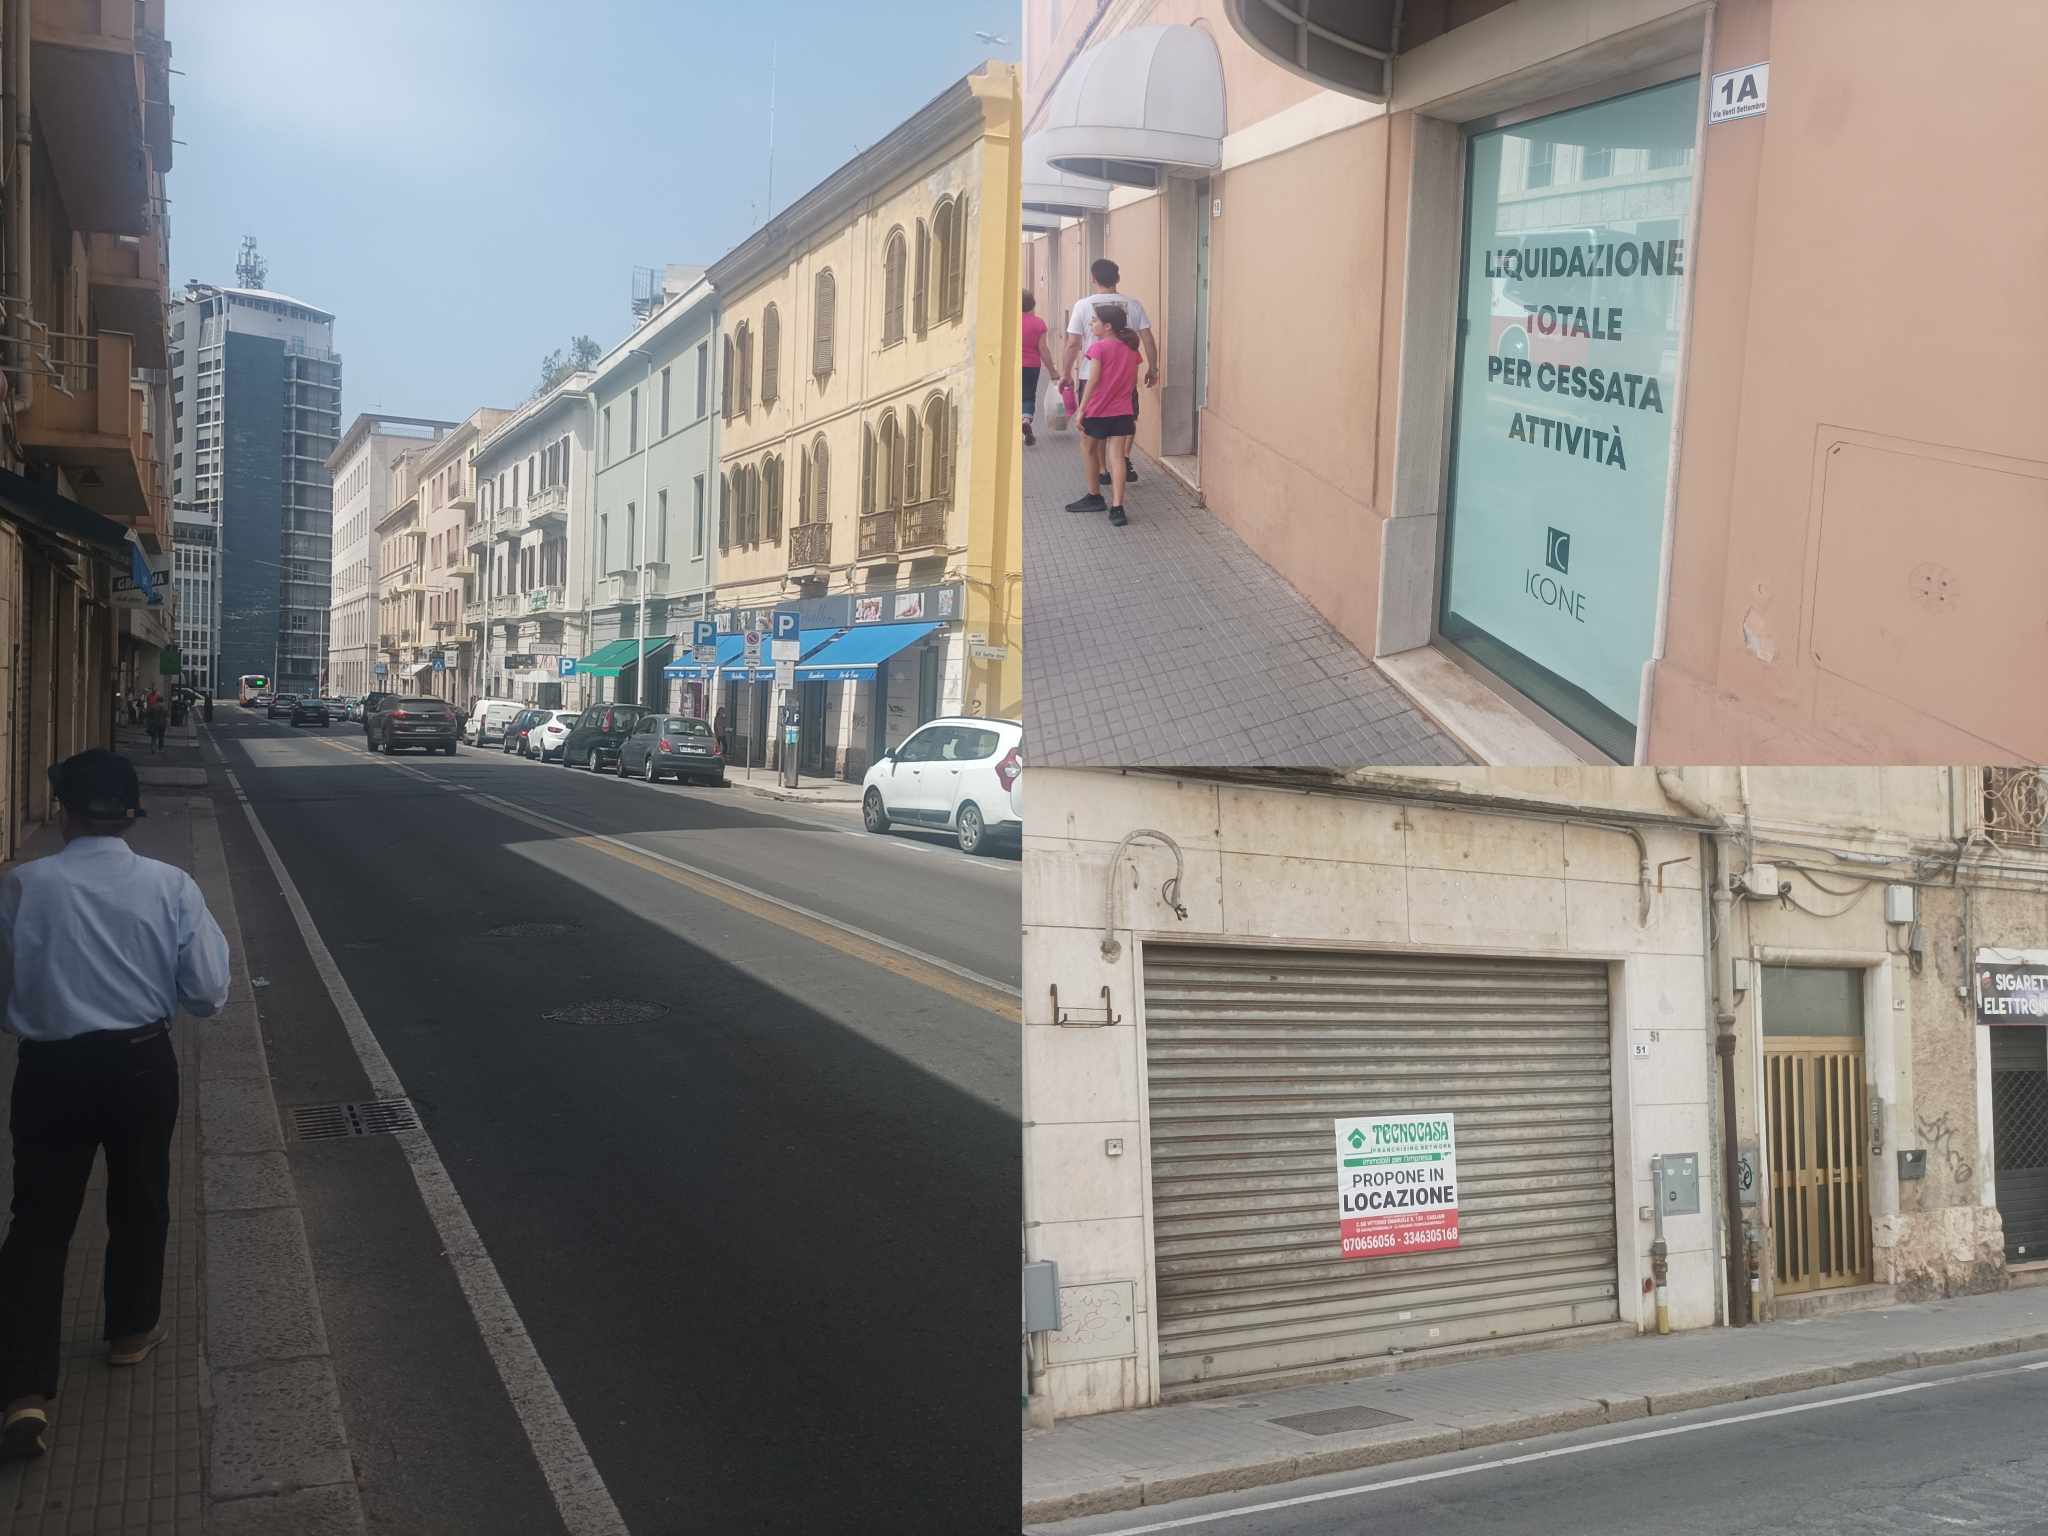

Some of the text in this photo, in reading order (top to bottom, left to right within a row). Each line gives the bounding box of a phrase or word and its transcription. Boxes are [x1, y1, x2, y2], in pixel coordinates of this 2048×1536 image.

[1721, 73, 1759, 105] 1A
[1712, 110, 1722, 119] Via
[1736, 102, 1766, 113] Settembre
[1485, 239, 1685, 282] LIQUIDAZIONE
[1524, 305, 1623, 341] TOTALE
[1488, 355, 1664, 414] PER CESSATA
[1508, 412, 1627, 472] ATTIVITÀ
[1524, 568, 1587, 624] ICONE
[697, 623, 713, 644] P
[778, 614, 795, 637] P
[561, 658, 573, 674] P
[1636, 1045, 1646, 1055] 51
[1372, 1121, 1449, 1145] TECNOCASA
[1352, 1167, 1444, 1188] PROPONE IN
[1343, 1185, 1454, 1213] LOCAZIONE
[1343, 1233, 1396, 1252] 070656056
[1403, 1228, 1458, 1246] 3346305168
